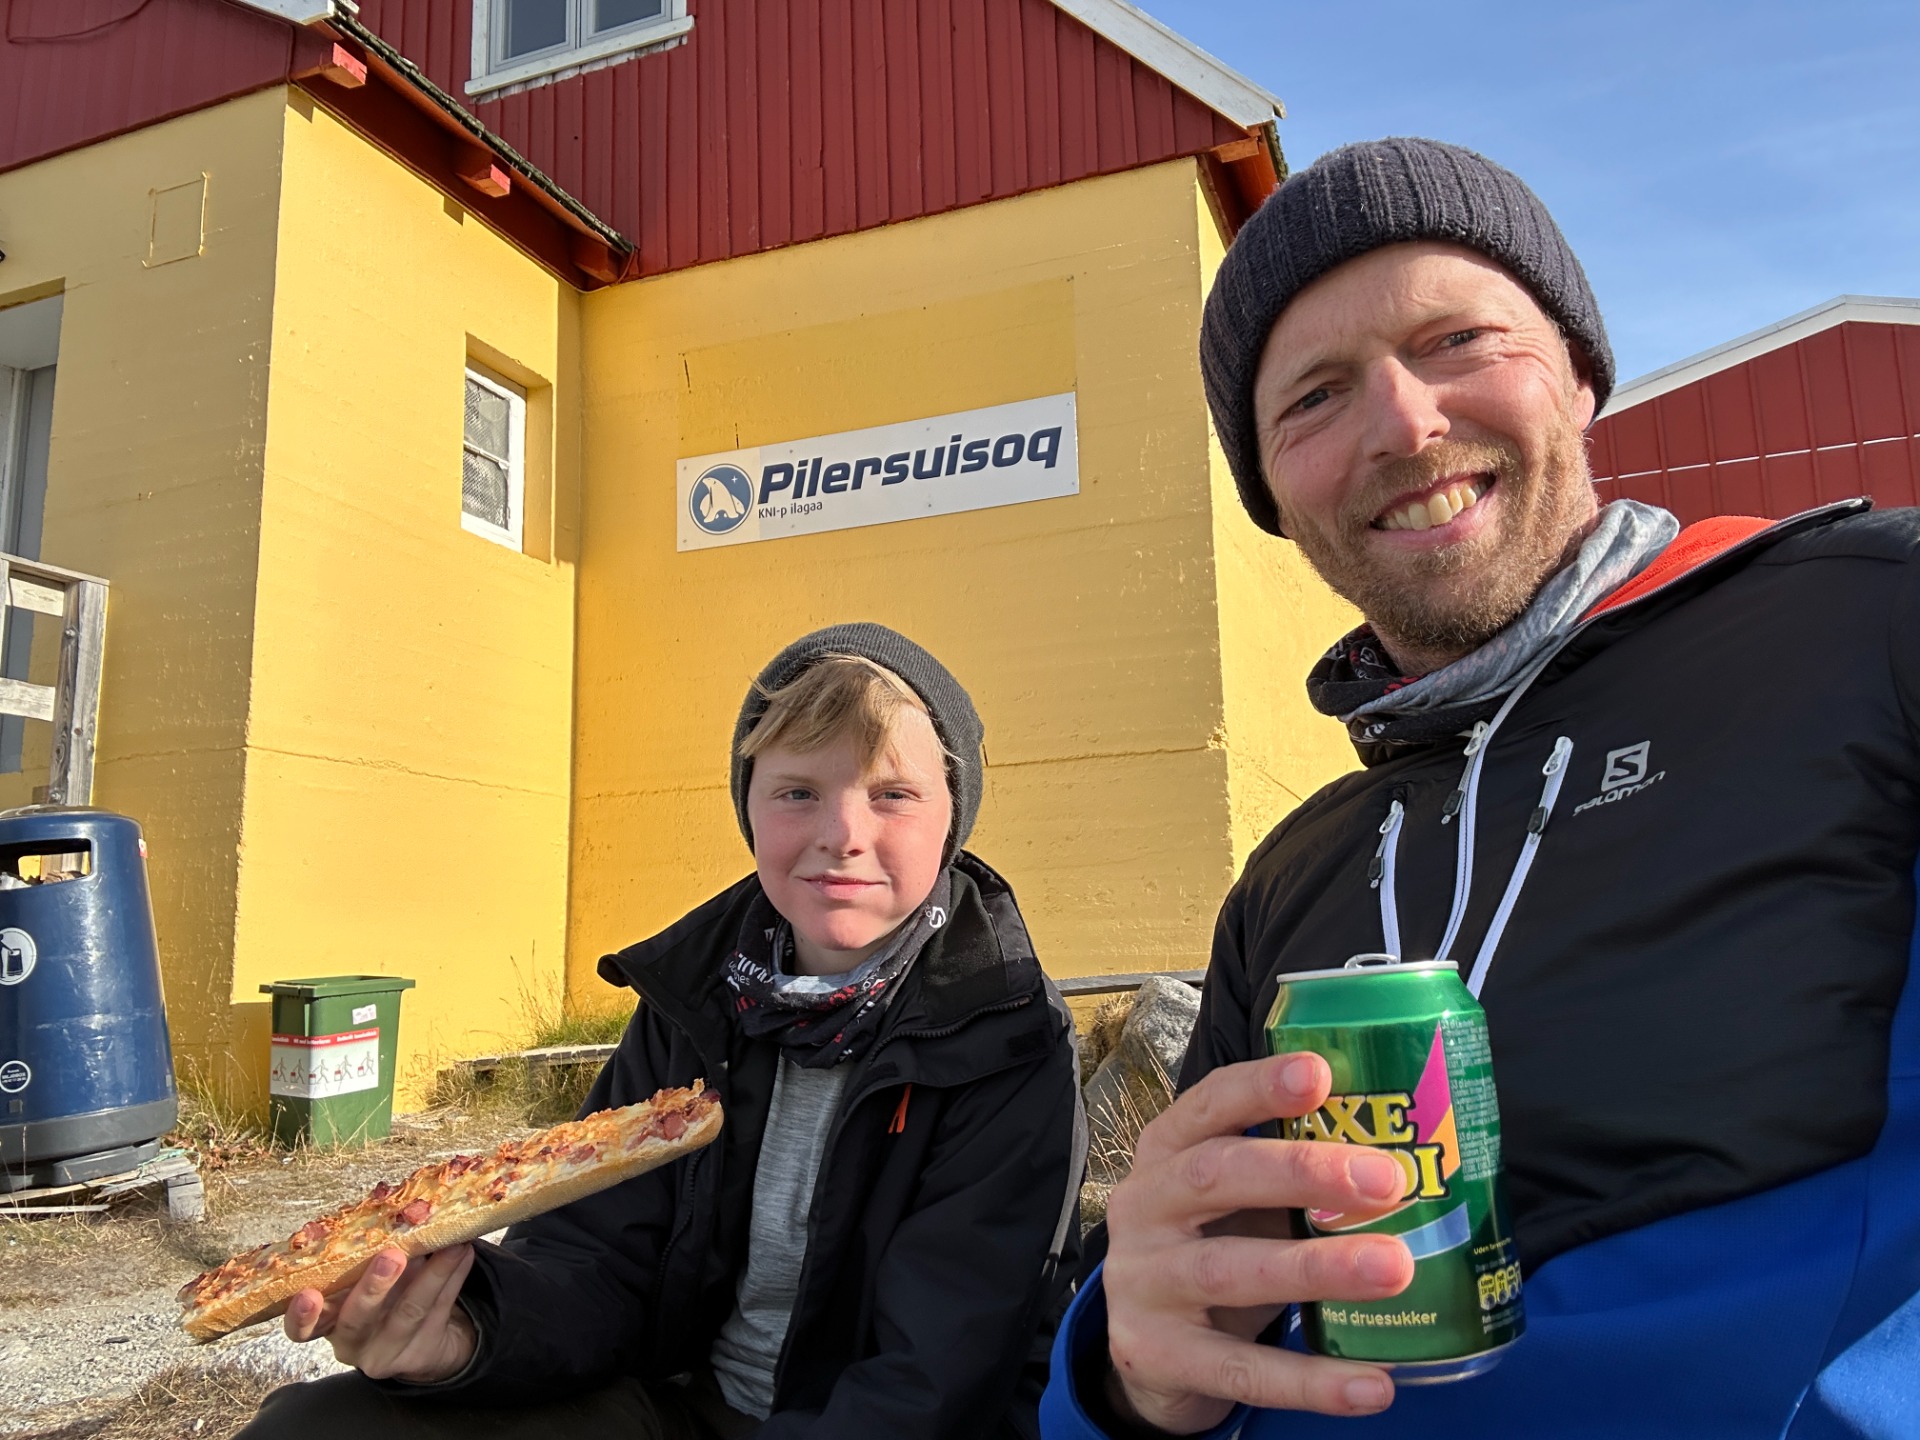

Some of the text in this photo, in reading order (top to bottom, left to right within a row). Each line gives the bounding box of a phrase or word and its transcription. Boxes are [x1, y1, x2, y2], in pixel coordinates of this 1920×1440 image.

[757, 425, 1063, 505] Pilersuisoq
[758, 501, 823, 519] KNI-p ilagaa
[1321, 1307, 1437, 1327] Med druesukker
